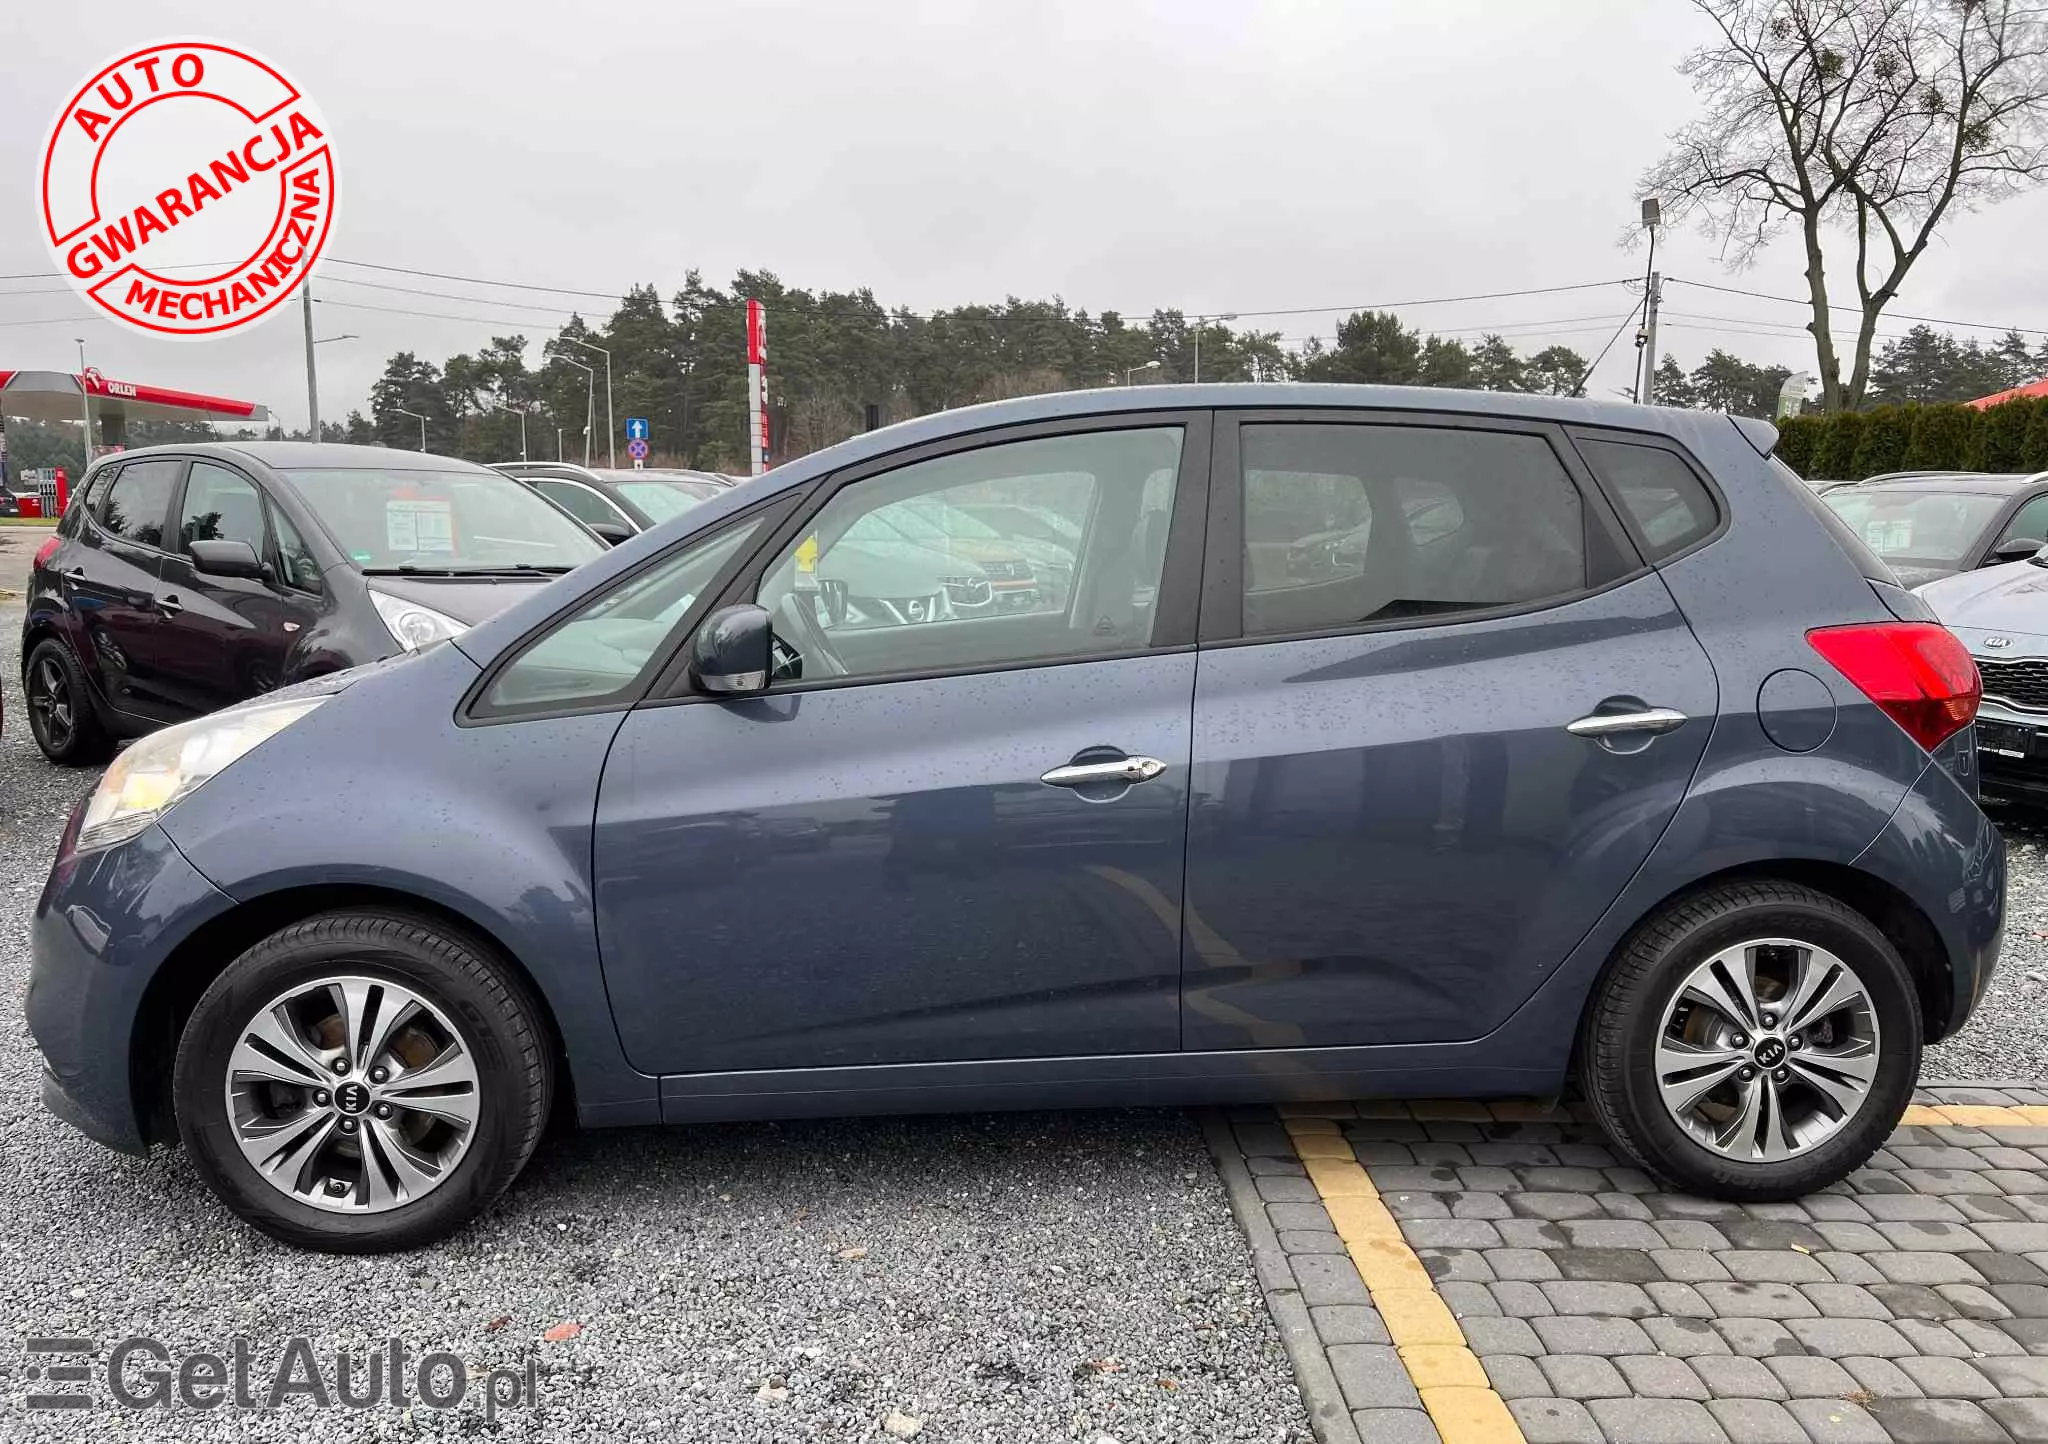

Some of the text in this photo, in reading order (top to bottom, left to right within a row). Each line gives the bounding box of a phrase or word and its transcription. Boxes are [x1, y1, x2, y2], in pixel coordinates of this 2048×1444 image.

[107, 381, 137, 397] ORLEN
[1758, 1044, 1783, 1064] KIA
[345, 1085, 358, 1111] KIA
